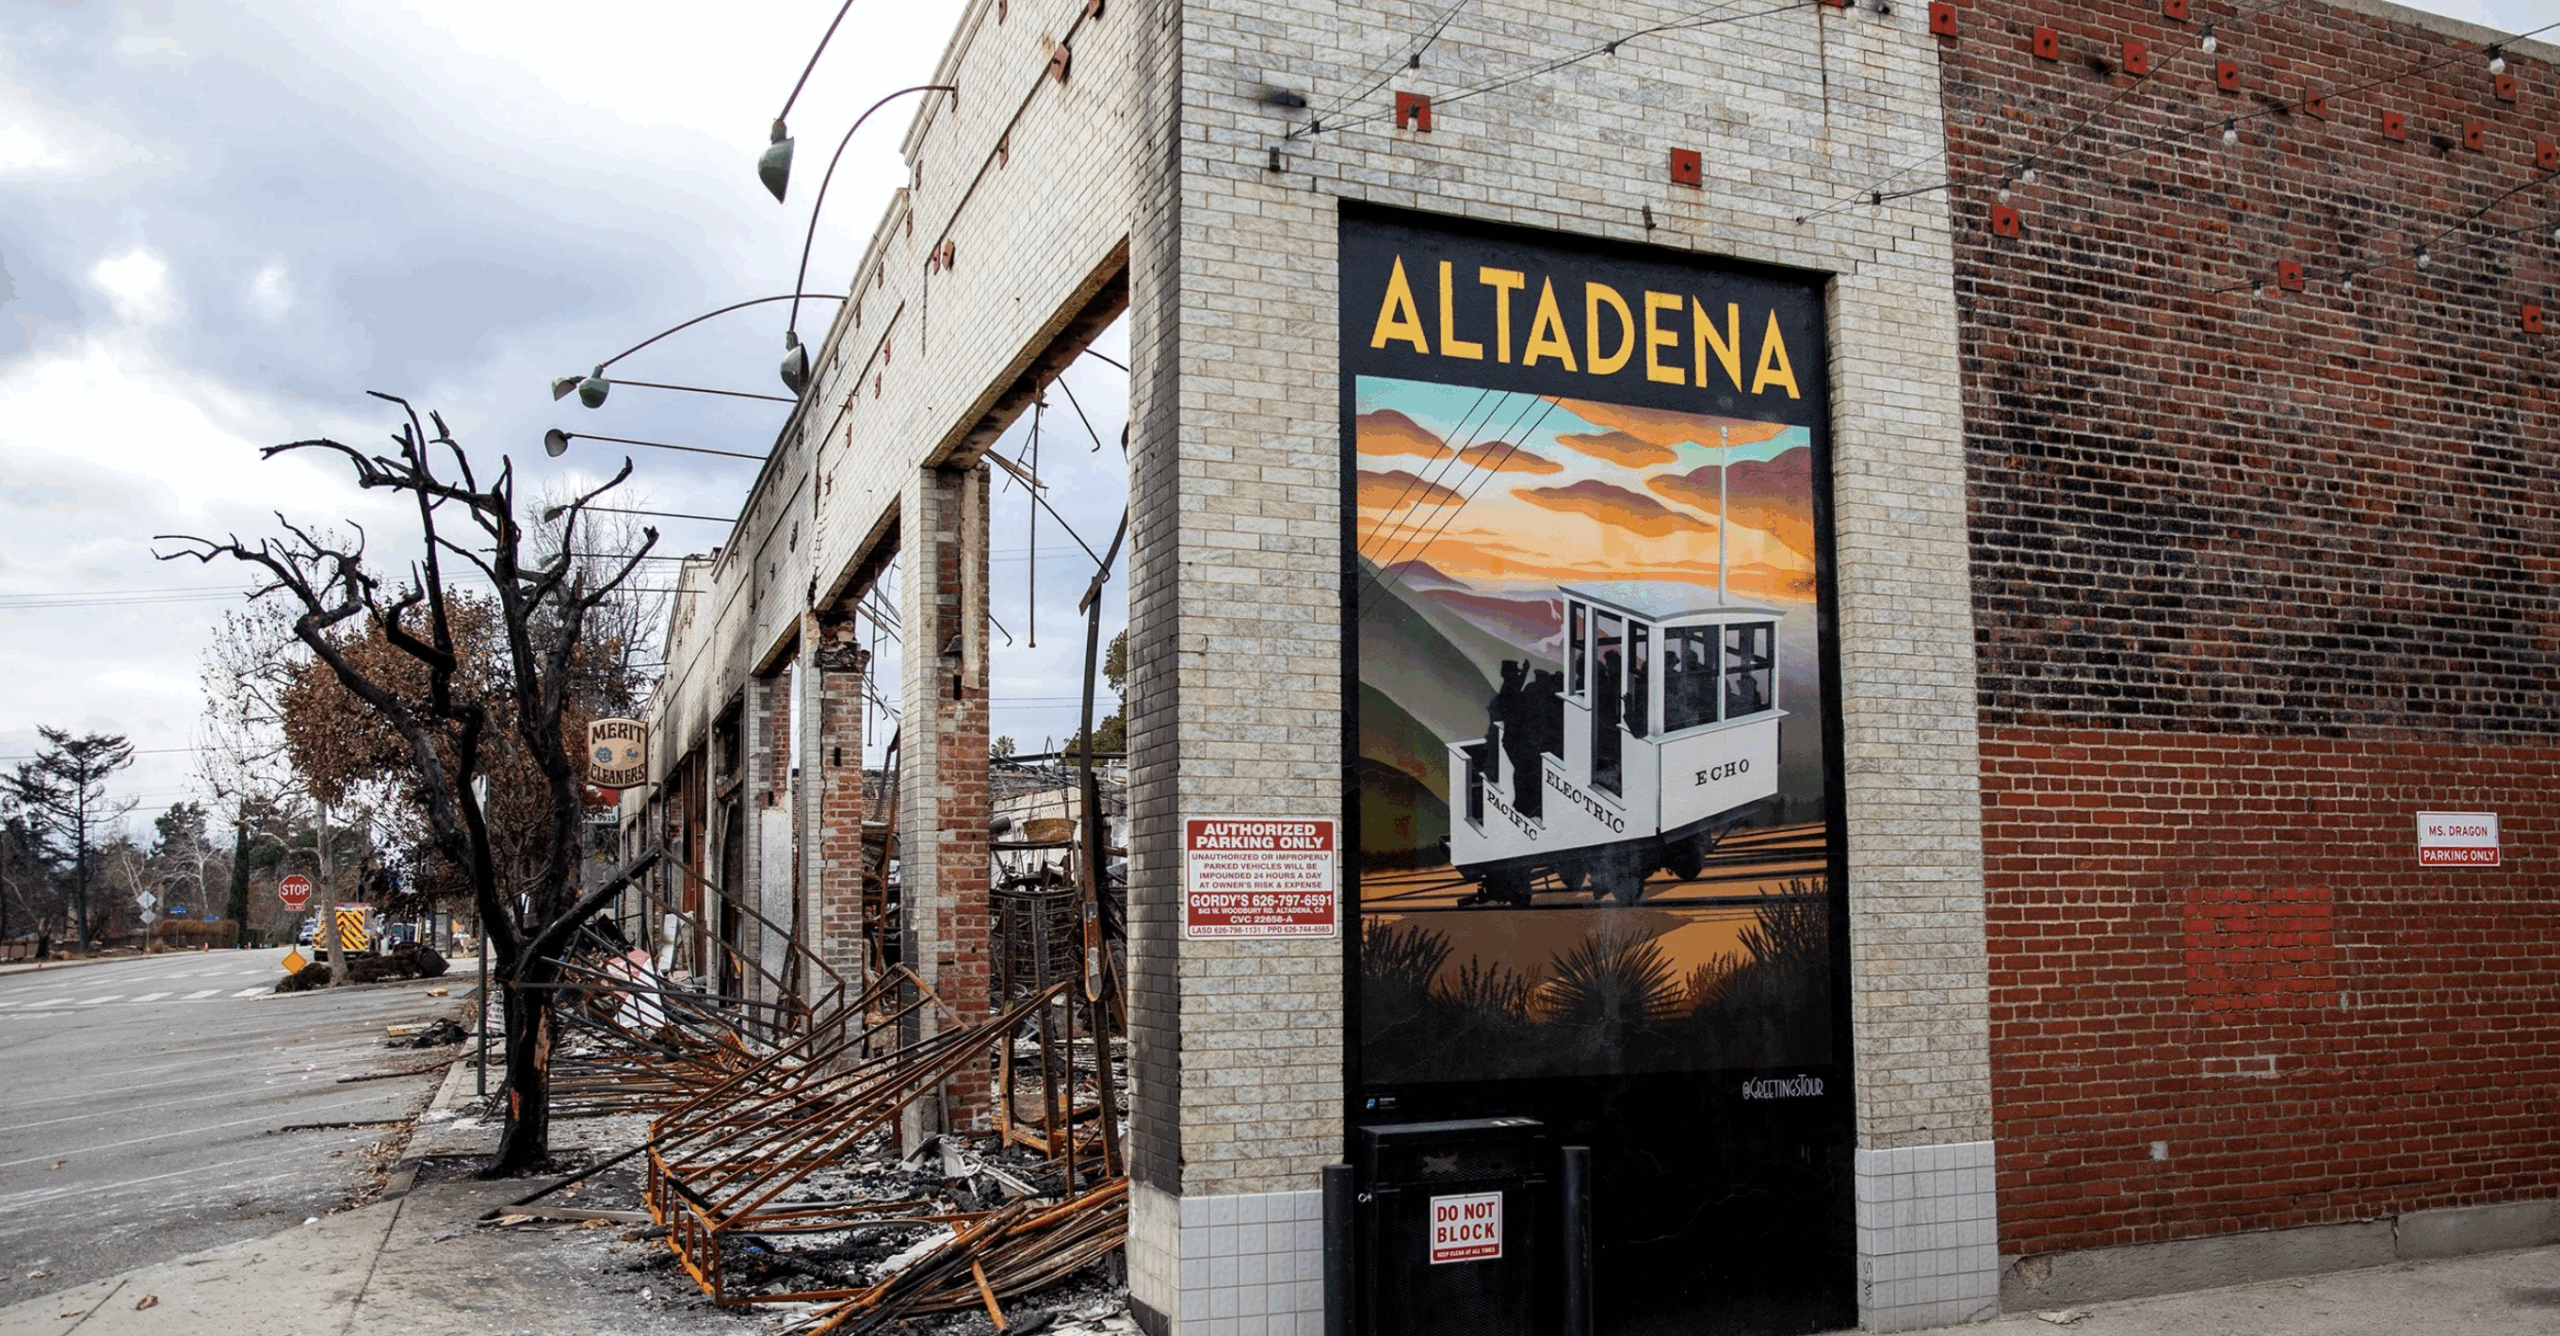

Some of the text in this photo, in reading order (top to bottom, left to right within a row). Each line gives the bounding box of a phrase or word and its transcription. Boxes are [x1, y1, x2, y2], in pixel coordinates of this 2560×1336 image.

[1370, 254, 1801, 400] ALTADENA
[591, 722, 646, 745] MERIT
[590, 763, 645, 784] CLEANERS
[1694, 758, 1750, 787] ECHO
[1545, 767, 1625, 834] ELECTRIC
[1486, 788, 1538, 842] PACIFIC
[1203, 823, 1316, 836] AUTHORIZED
[2428, 826, 2488, 836] MS. DRAGON
[1196, 836, 1324, 849] PARKING ONLY
[1276, 853, 1329, 861] IMPROPERLY
[2423, 850, 2495, 861] PARKING ONLY
[1204, 862, 1318, 870] PARKED VEHICLES WILL BE
[281, 884, 310, 896] STOP
[1199, 881, 1323, 889] AT OWNER'S RISK & EXPENSE
[1190, 894, 1332, 907] GORDY'S 626-797-6591
[1230, 915, 1251, 923] CVC
[1192, 926, 1212, 934] LASD
[1437, 1202, 1495, 1222] DO NOT
[1437, 1222, 1495, 1243] BLOCK
